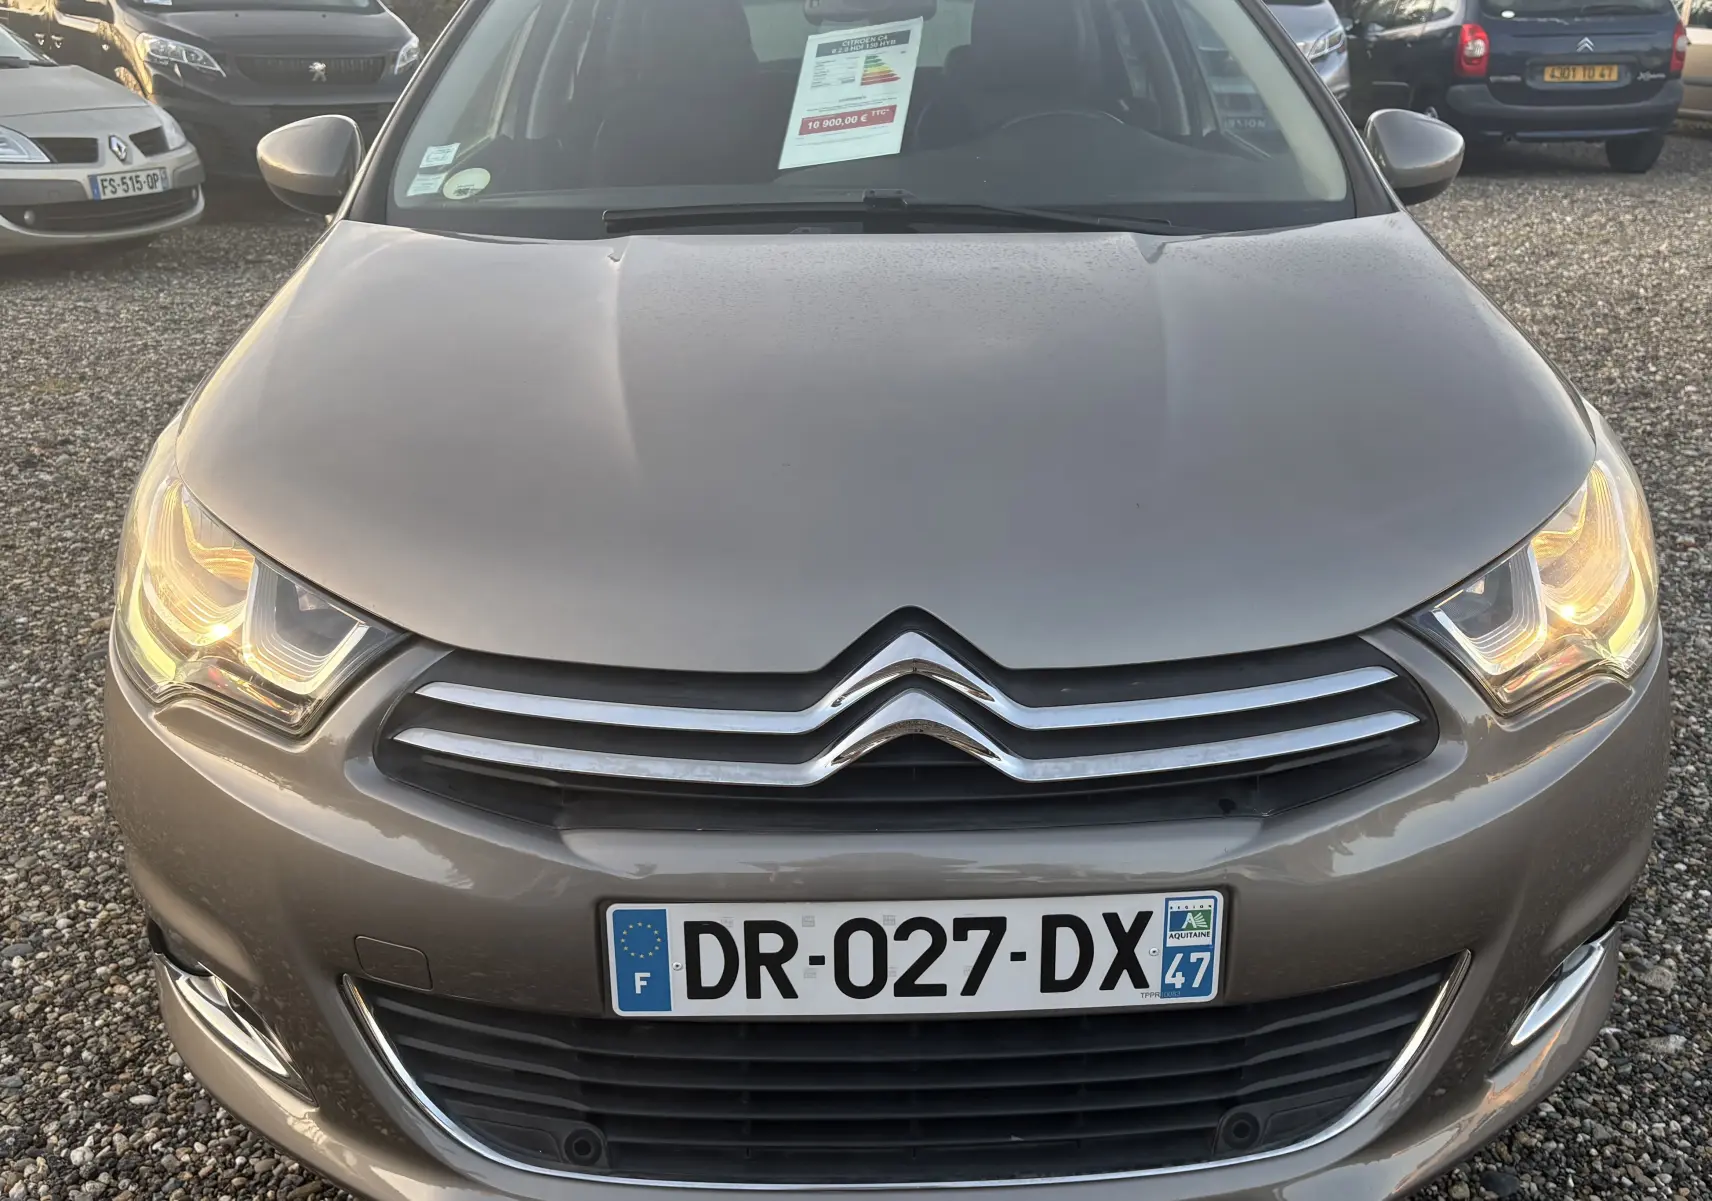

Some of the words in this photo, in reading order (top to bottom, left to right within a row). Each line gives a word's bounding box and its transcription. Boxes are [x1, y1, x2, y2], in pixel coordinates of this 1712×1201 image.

[807, 121, 820, 129] 10
[822, 115, 858, 127] 900,00
[860, 113, 868, 122] €
[1168, 930, 1211, 940] AQUITAINE
[684, 910, 1154, 1000] DR-027-DX
[1164, 951, 1211, 989] 47
[634, 971, 651, 995] F
